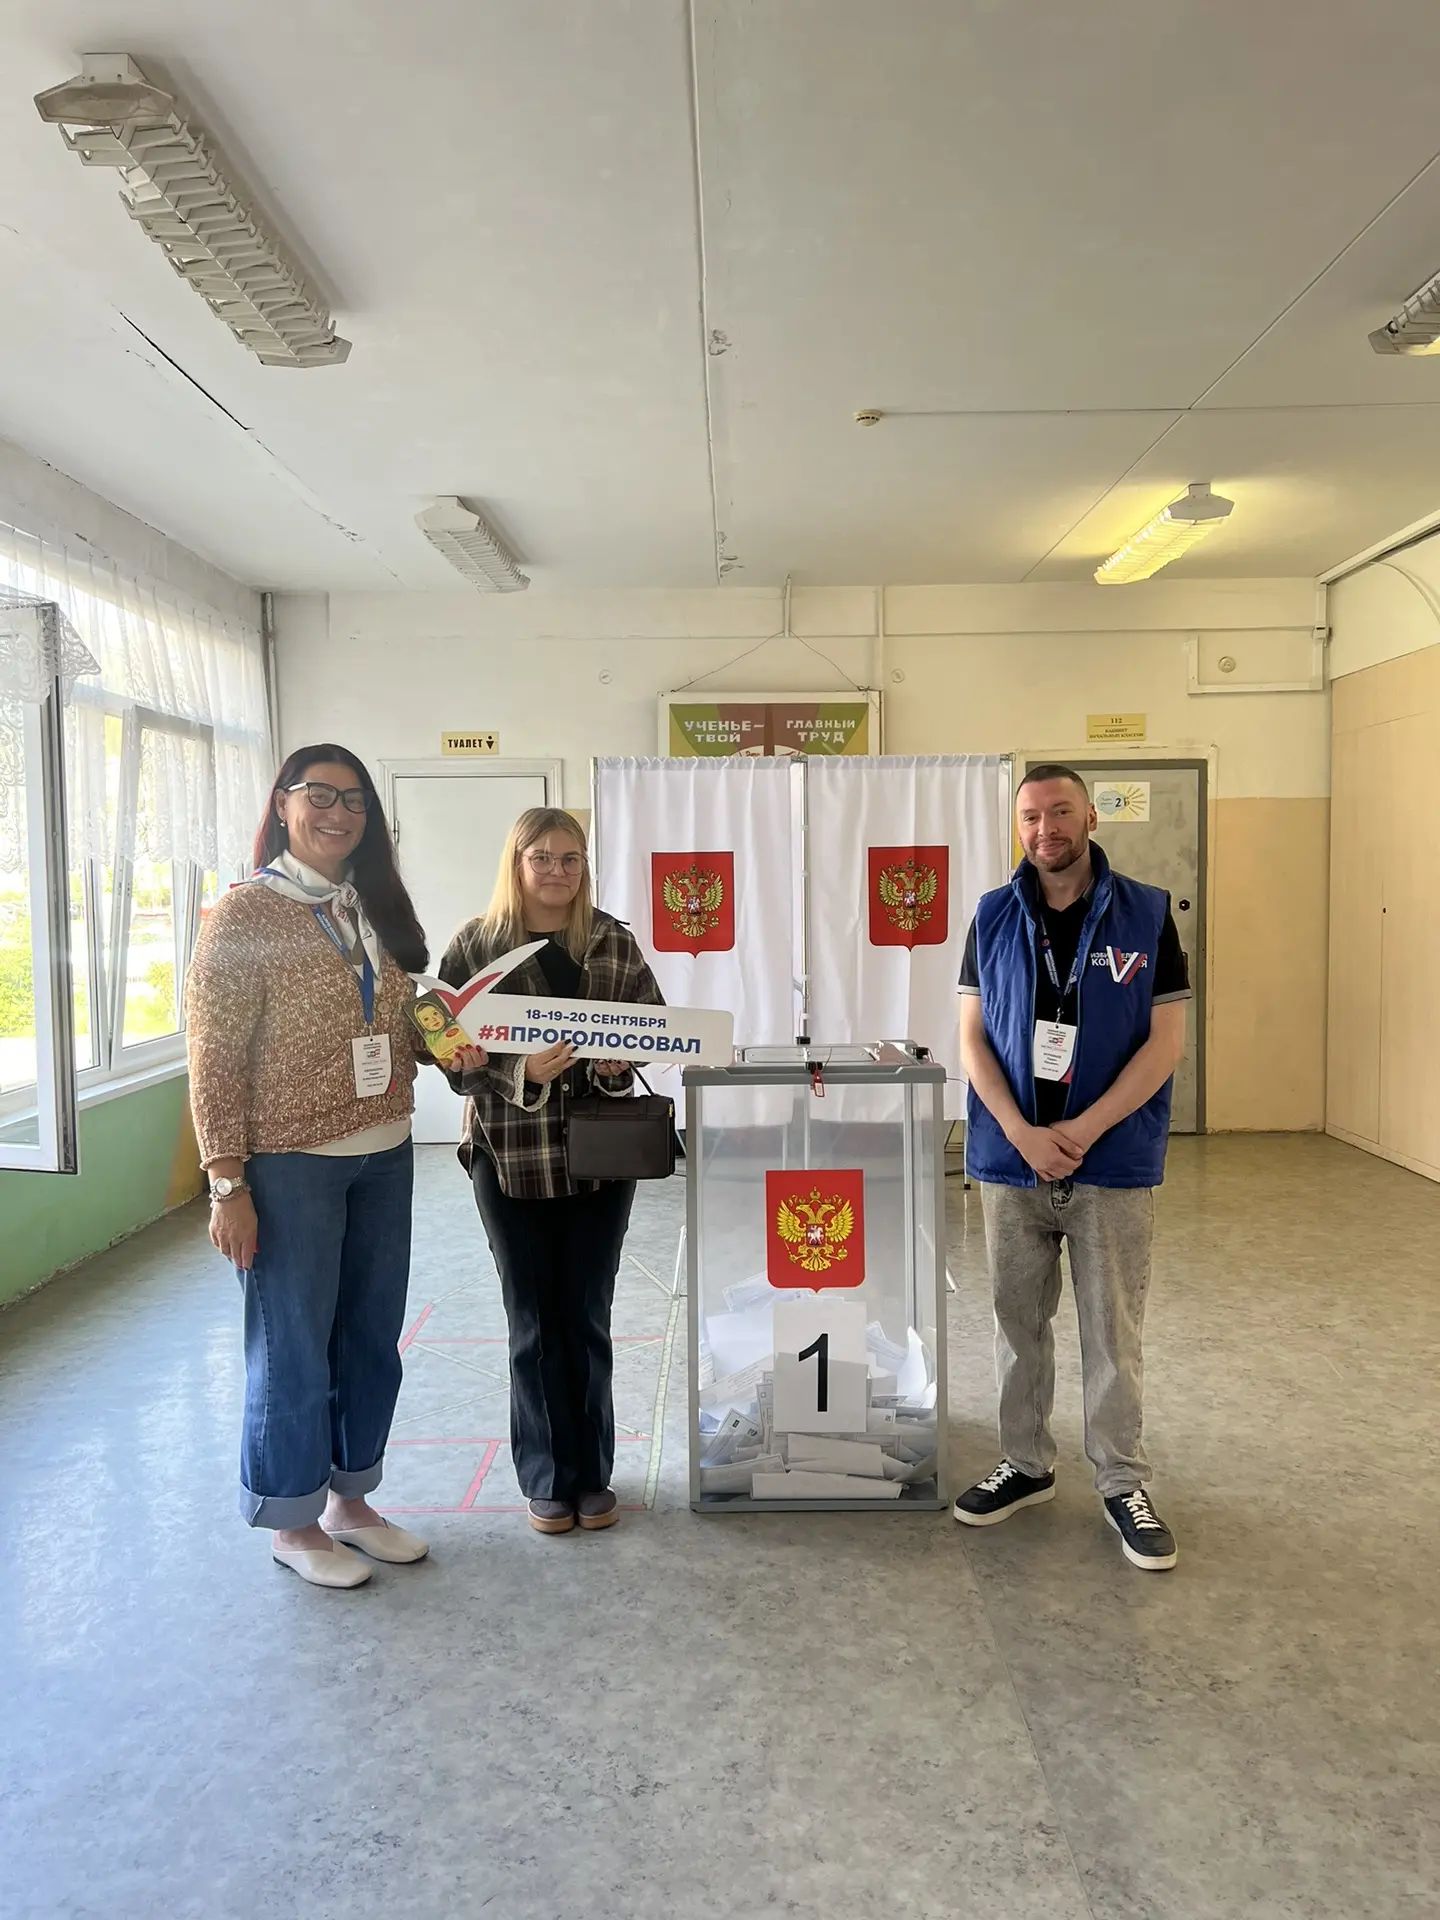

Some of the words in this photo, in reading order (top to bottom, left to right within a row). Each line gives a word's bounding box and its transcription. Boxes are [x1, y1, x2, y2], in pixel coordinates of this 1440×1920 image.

[447, 738, 483, 748] ТУАЛЕТ
[695, 732, 741, 743] ТВОЙ
[797, 731, 845, 743] ТРУД
[526, 1009, 587, 1022] 18-19-20
[590, 1013, 667, 1028] СЕНТЯБРЯ
[478, 1024, 701, 1054] #ЯПРОГОЛОСОВАЛ
[798, 1333, 829, 1412] 1
